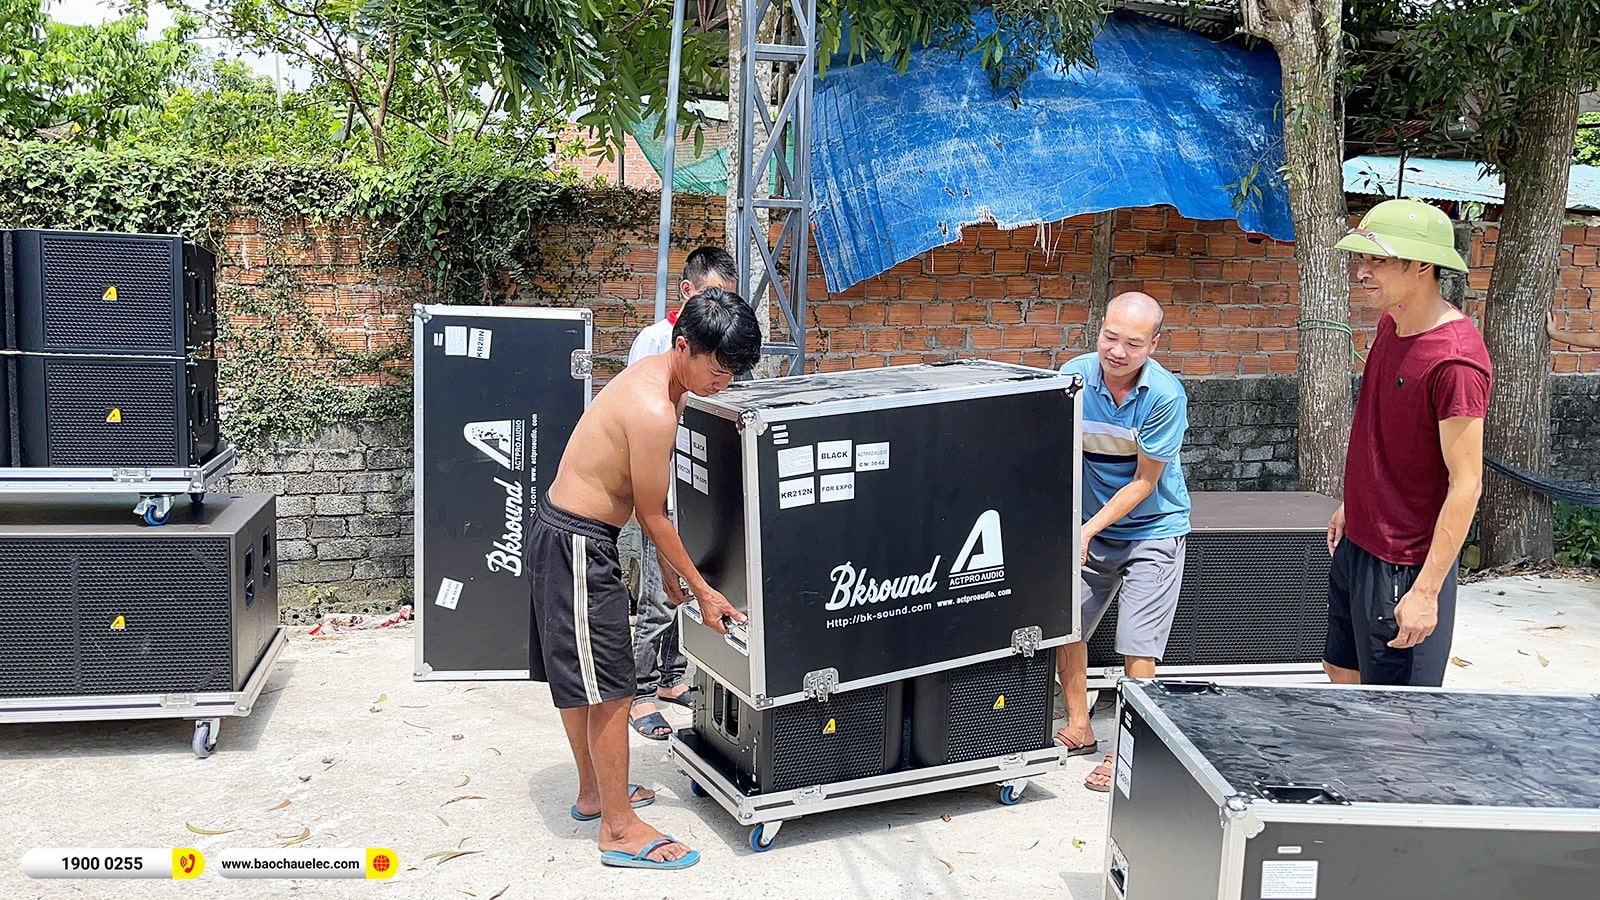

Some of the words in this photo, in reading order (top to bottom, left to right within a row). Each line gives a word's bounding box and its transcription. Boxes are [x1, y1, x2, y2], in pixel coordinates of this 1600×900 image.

[514, 419, 522, 442] AUDIO
[514, 442, 522, 471] ACTPRO
[820, 450, 849, 460] BLACK
[780, 487, 813, 499] KR212N
[835, 483, 853, 491] EXPO
[485, 477, 524, 577] Bksound
[825, 555, 941, 611] Bksound
[949, 573, 980, 586] ACTPRO
[980, 570, 1005, 580] AUDIO
[826, 602, 932, 629] Http://bk-sound.com
